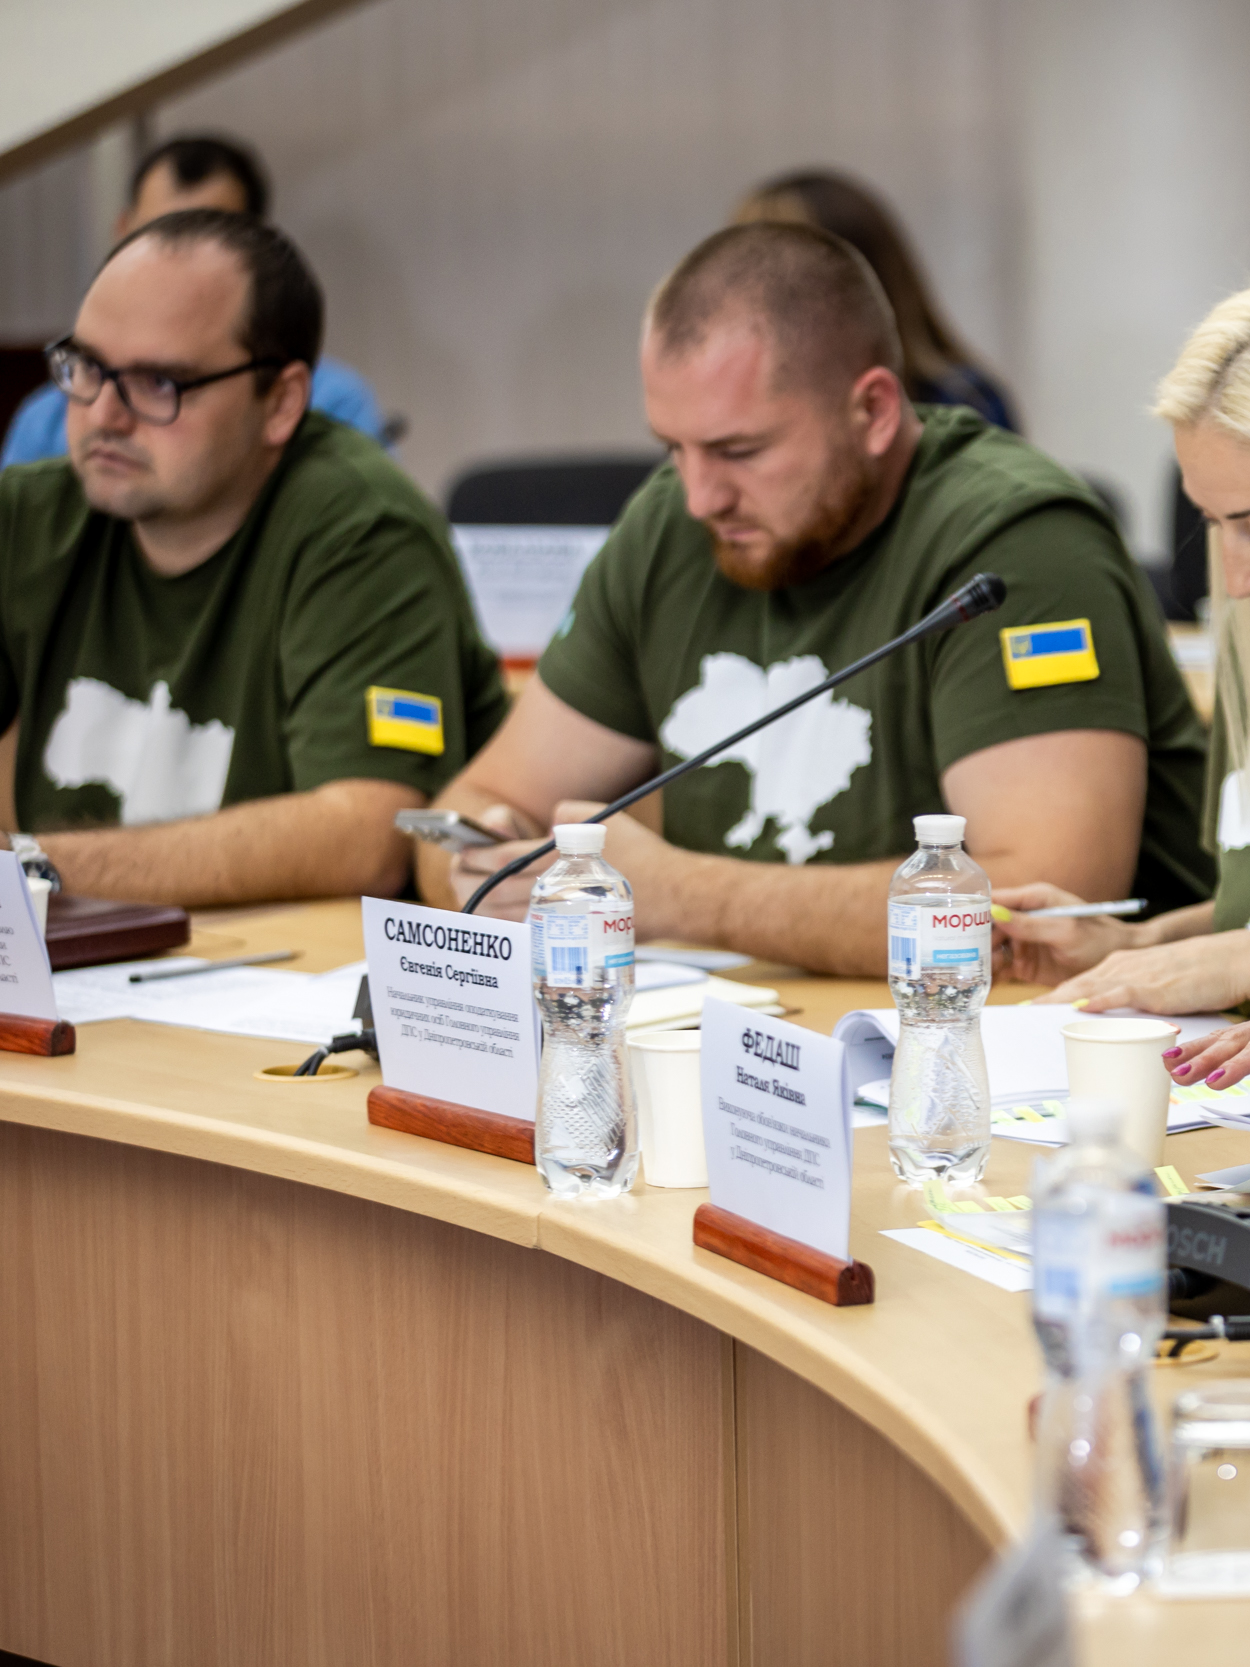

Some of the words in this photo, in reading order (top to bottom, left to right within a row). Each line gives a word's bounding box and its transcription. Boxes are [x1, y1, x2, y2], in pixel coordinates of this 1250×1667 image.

[384, 917, 512, 961] САМСОНЕНКО
[604, 916, 634, 935] мор
[400, 956, 443, 978] Євгенія
[445, 964, 499, 988] Сергіївна
[741, 1027, 801, 1071] ФЕДАШ
[736, 1065, 770, 1094] Наталя
[772, 1078, 807, 1106] Яківна
[1166, 1224, 1228, 1265] OSCH
